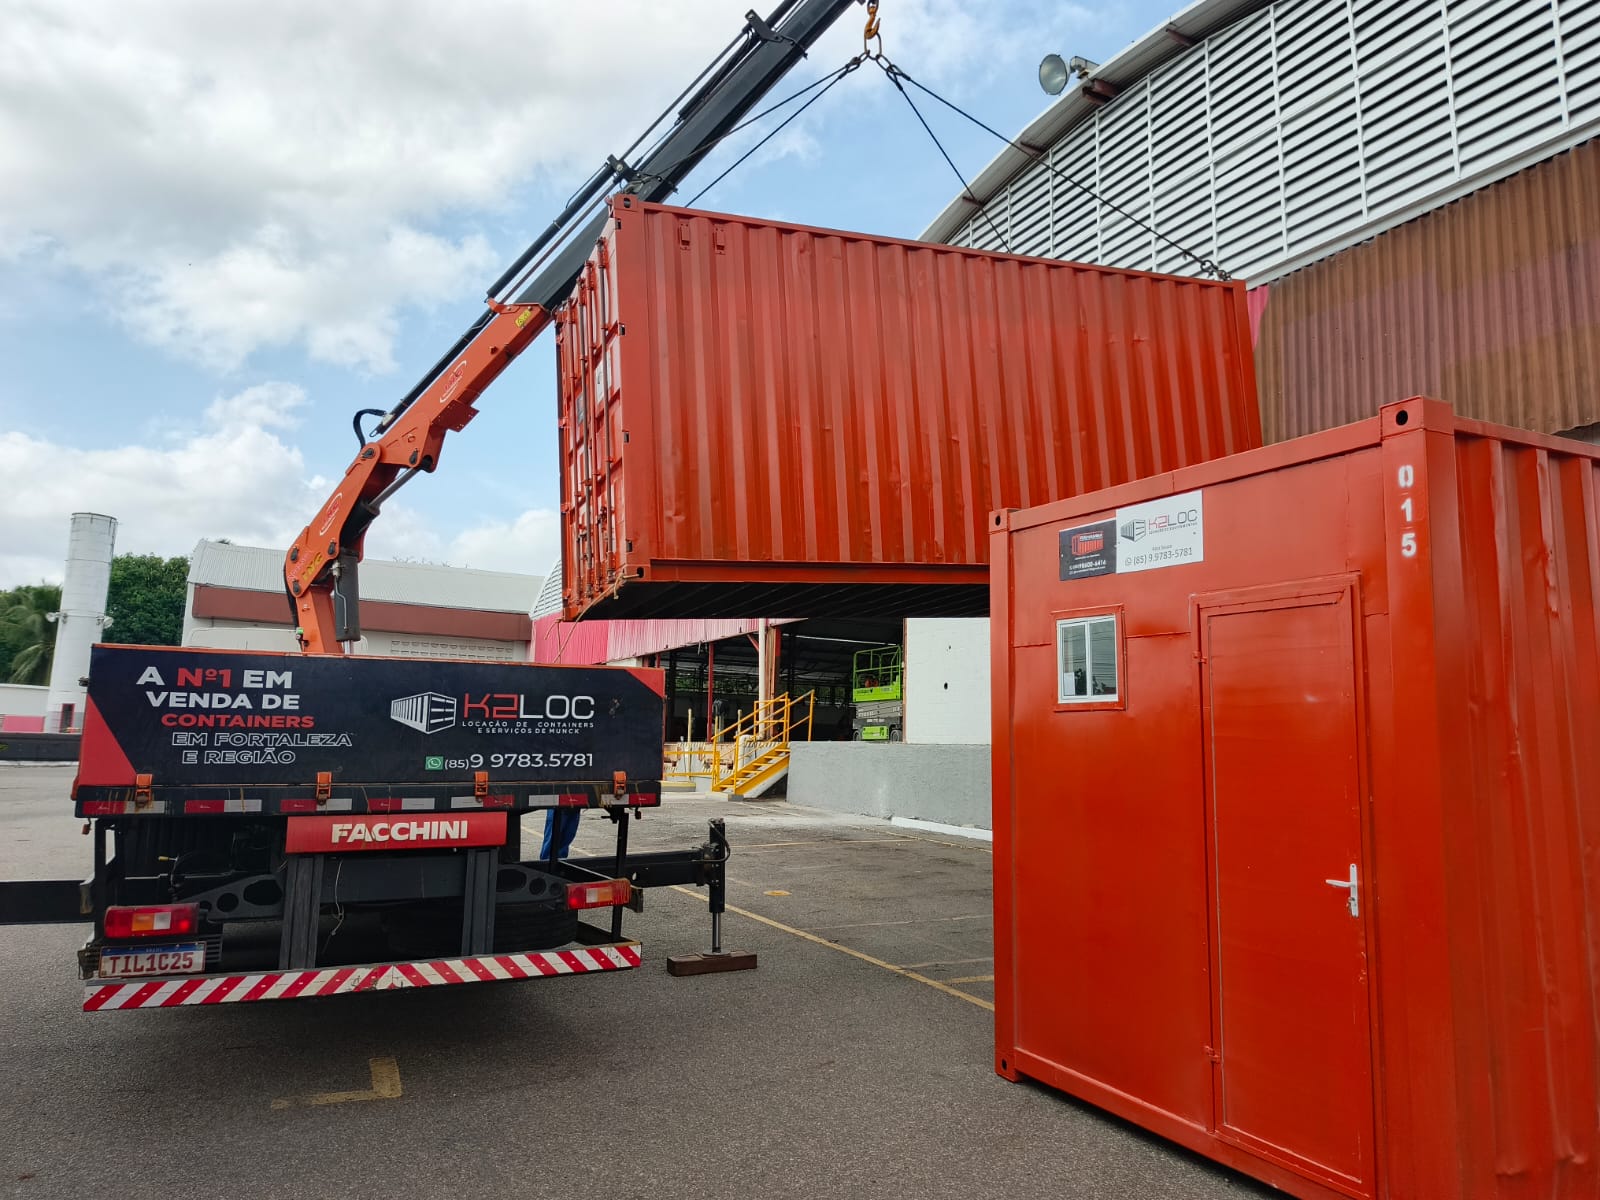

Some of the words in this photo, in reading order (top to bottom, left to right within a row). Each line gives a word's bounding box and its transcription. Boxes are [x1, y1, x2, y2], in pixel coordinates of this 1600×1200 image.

[1148, 509, 1198, 530] K2LOC
[136, 666, 165, 685] A
[243, 669, 293, 689] EM
[145, 691, 253, 710] VENDA
[261, 694, 300, 710] DE
[463, 693, 595, 720] K2LOC
[161, 713, 315, 729] CONTAINERS
[462, 720, 508, 728] LOCAÇÃO
[537, 721, 594, 729] CONTAINERS
[171, 732, 208, 747] EM
[214, 732, 353, 748] FORTALEZA
[182, 750, 199, 765] E
[203, 747, 297, 765] REGIÃO
[490, 753, 594, 769] 9783.5781
[331, 820, 469, 844] FACCHINI
[109, 952, 195, 974] TIL1C25
